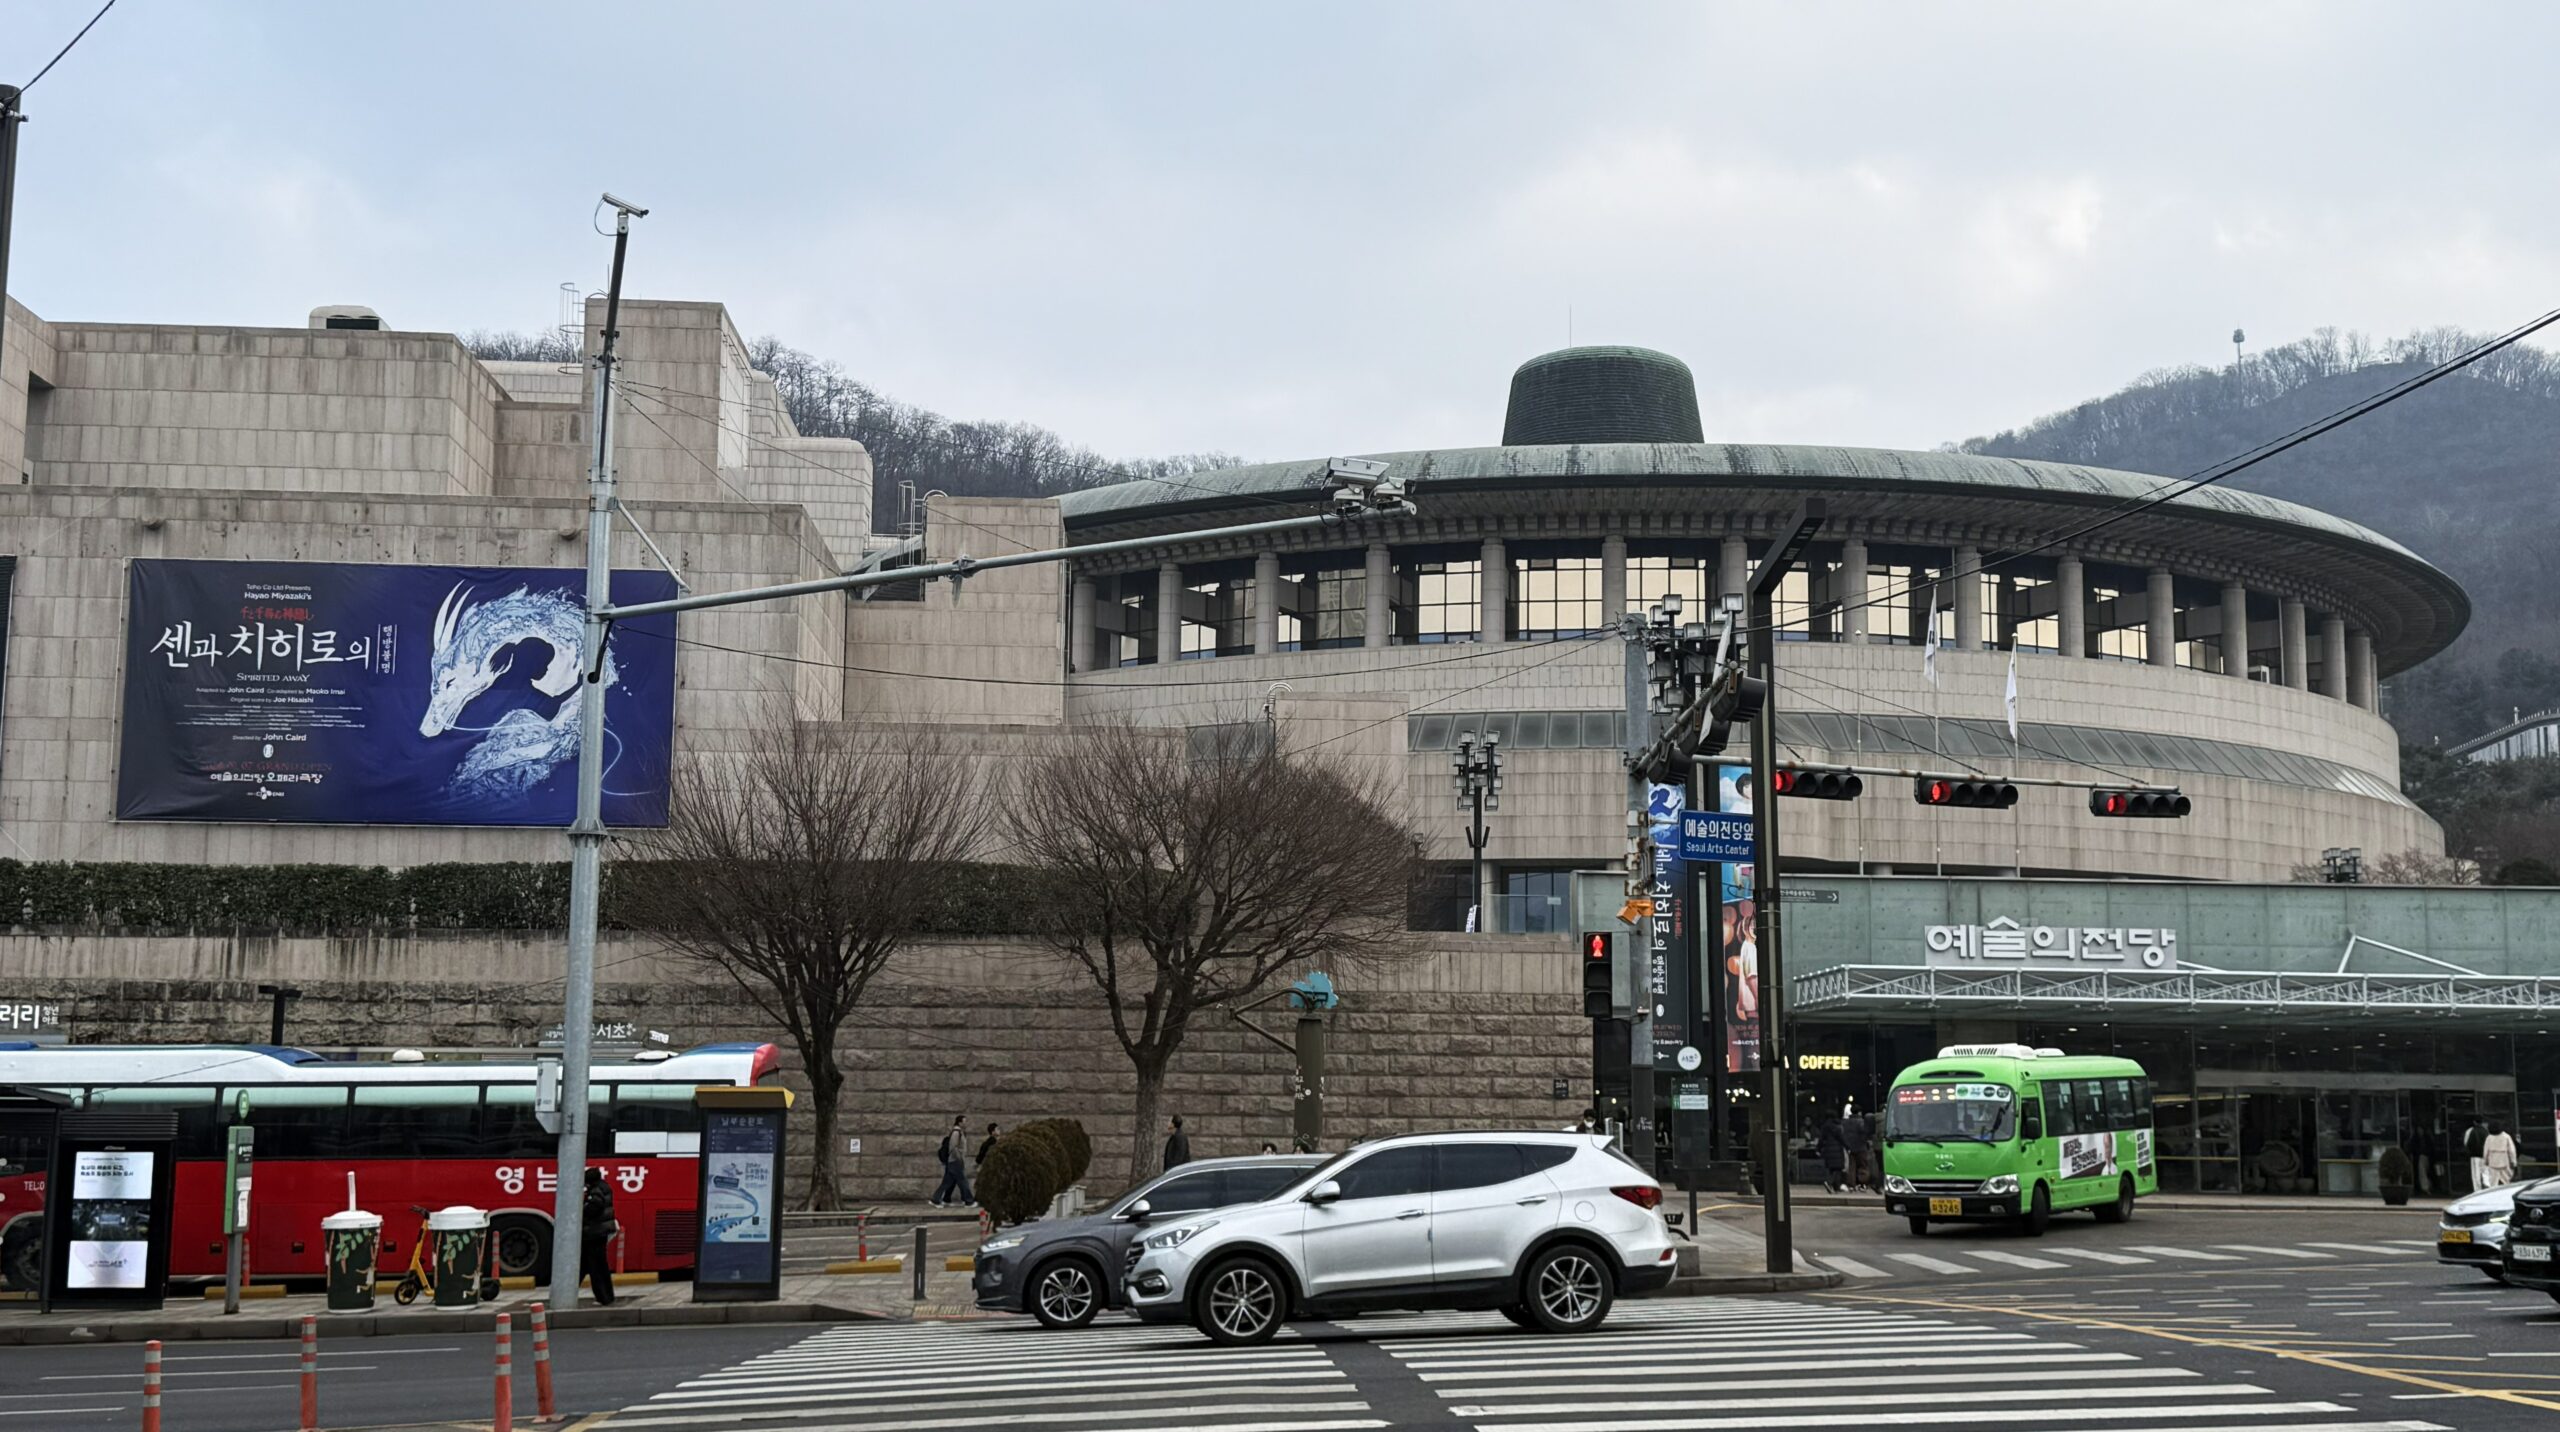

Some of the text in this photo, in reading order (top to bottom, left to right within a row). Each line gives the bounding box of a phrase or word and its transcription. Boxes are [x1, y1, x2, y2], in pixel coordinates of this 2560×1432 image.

[244, 592, 312, 601] Hayao Miyazaki's
[150, 620, 371, 671] 센과 치히로의
[282, 674, 311, 683] AWAY
[273, 696, 287, 704] Joe
[287, 696, 315, 704] Hisaishi
[263, 733, 284, 742] John
[285, 733, 307, 742] Caird
[1686, 841, 1750, 856] Seoul Arts Center
[1926, 916, 2177, 968] 예술의전당
[596, 1022, 627, 1039] 서초
[1799, 1055, 1850, 1070] COFFEE
